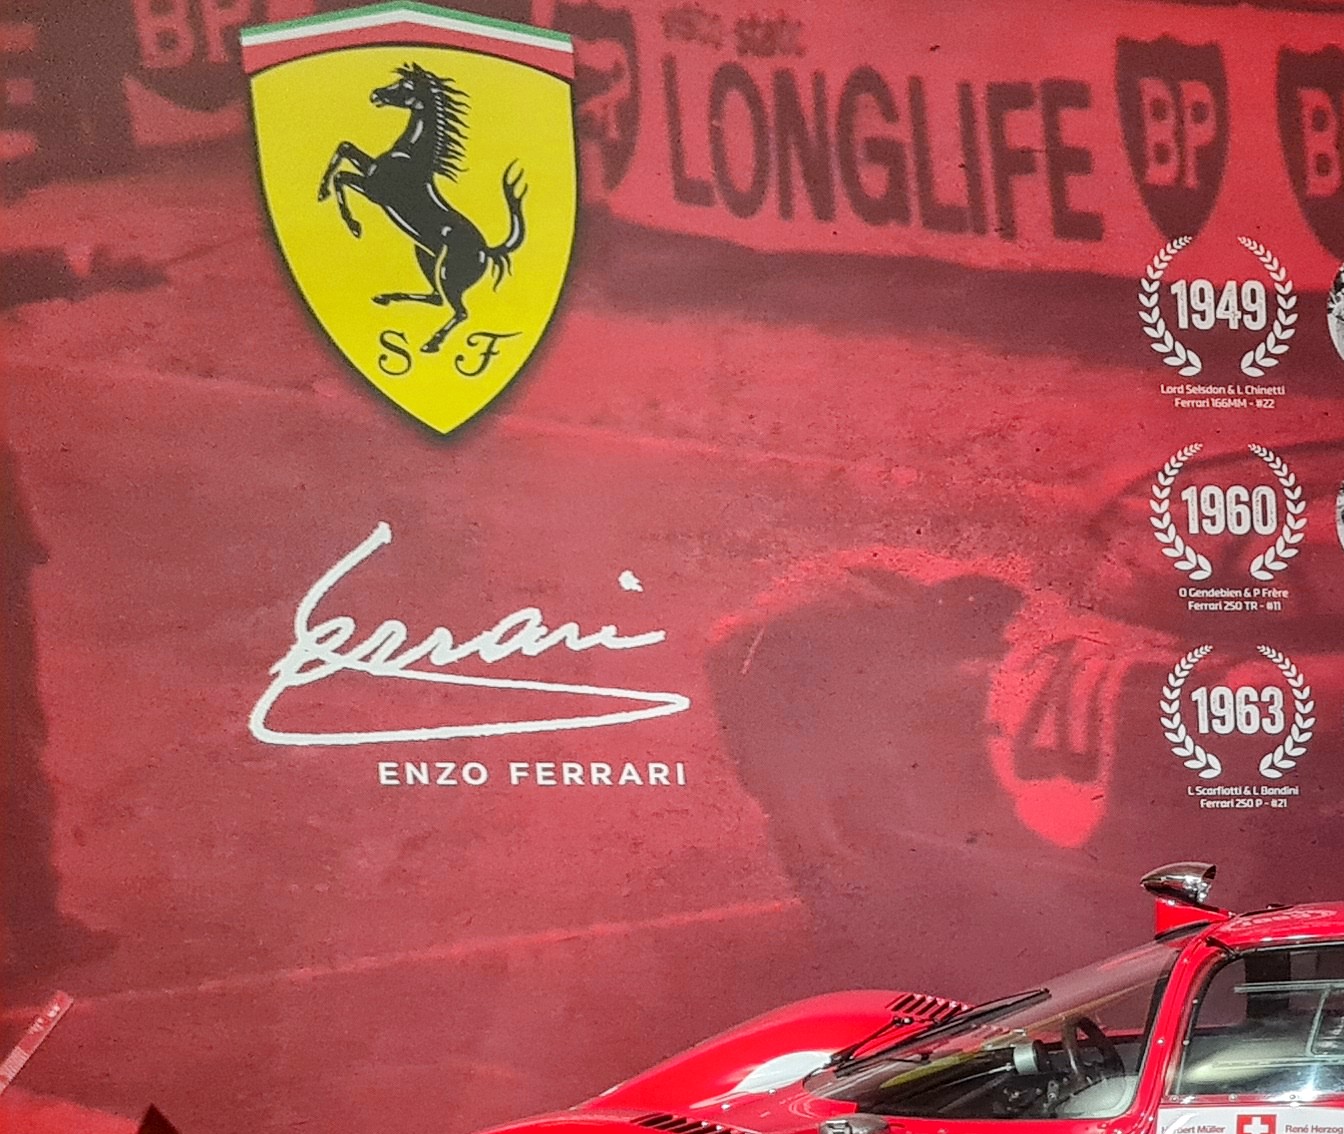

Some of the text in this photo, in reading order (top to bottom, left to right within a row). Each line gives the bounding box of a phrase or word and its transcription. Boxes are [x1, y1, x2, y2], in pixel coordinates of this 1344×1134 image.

[1142, 77, 1217, 188] BP
[661, 54, 1104, 242] LONGLIFE
[1170, 279, 1267, 331] 1949
[377, 329, 413, 376] S
[1159, 384, 1185, 396] Lord
[1185, 384, 1226, 396] Selsdon
[1226, 384, 1236, 396] &
[1244, 384, 1286, 396] Chinetti
[1173, 398, 1210, 409] Ferrari
[1210, 398, 1248, 409] 166MM
[1255, 398, 1275, 409] #22
[1181, 484, 1279, 536] 1960
[1188, 588, 1243, 598] Gendebien
[1242, 588, 1252, 598] &
[1252, 588, 1261, 598] P
[1261, 588, 1290, 598] Frère
[1187, 601, 1224, 611] Ferrari
[1223, 601, 1243, 611] 250
[1243, 601, 1259, 611] TR
[1265, 601, 1282, 611] #11
[1190, 685, 1285, 735] 1963
[378, 761, 686, 786] ENZO FERRARI
[1194, 785, 1243, 796] Scarfiotti
[1242, 785, 1252, 796] &
[1259, 785, 1300, 796] Bandini
[1199, 798, 1235, 808] Ferrari
[1234, 798, 1255, 808] 250
[1255, 798, 1263, 808] P
[1269, 798, 1288, 808] #21
[1197, 1124, 1226, 1134] Müller
[1285, 1124, 1309, 1134] René
